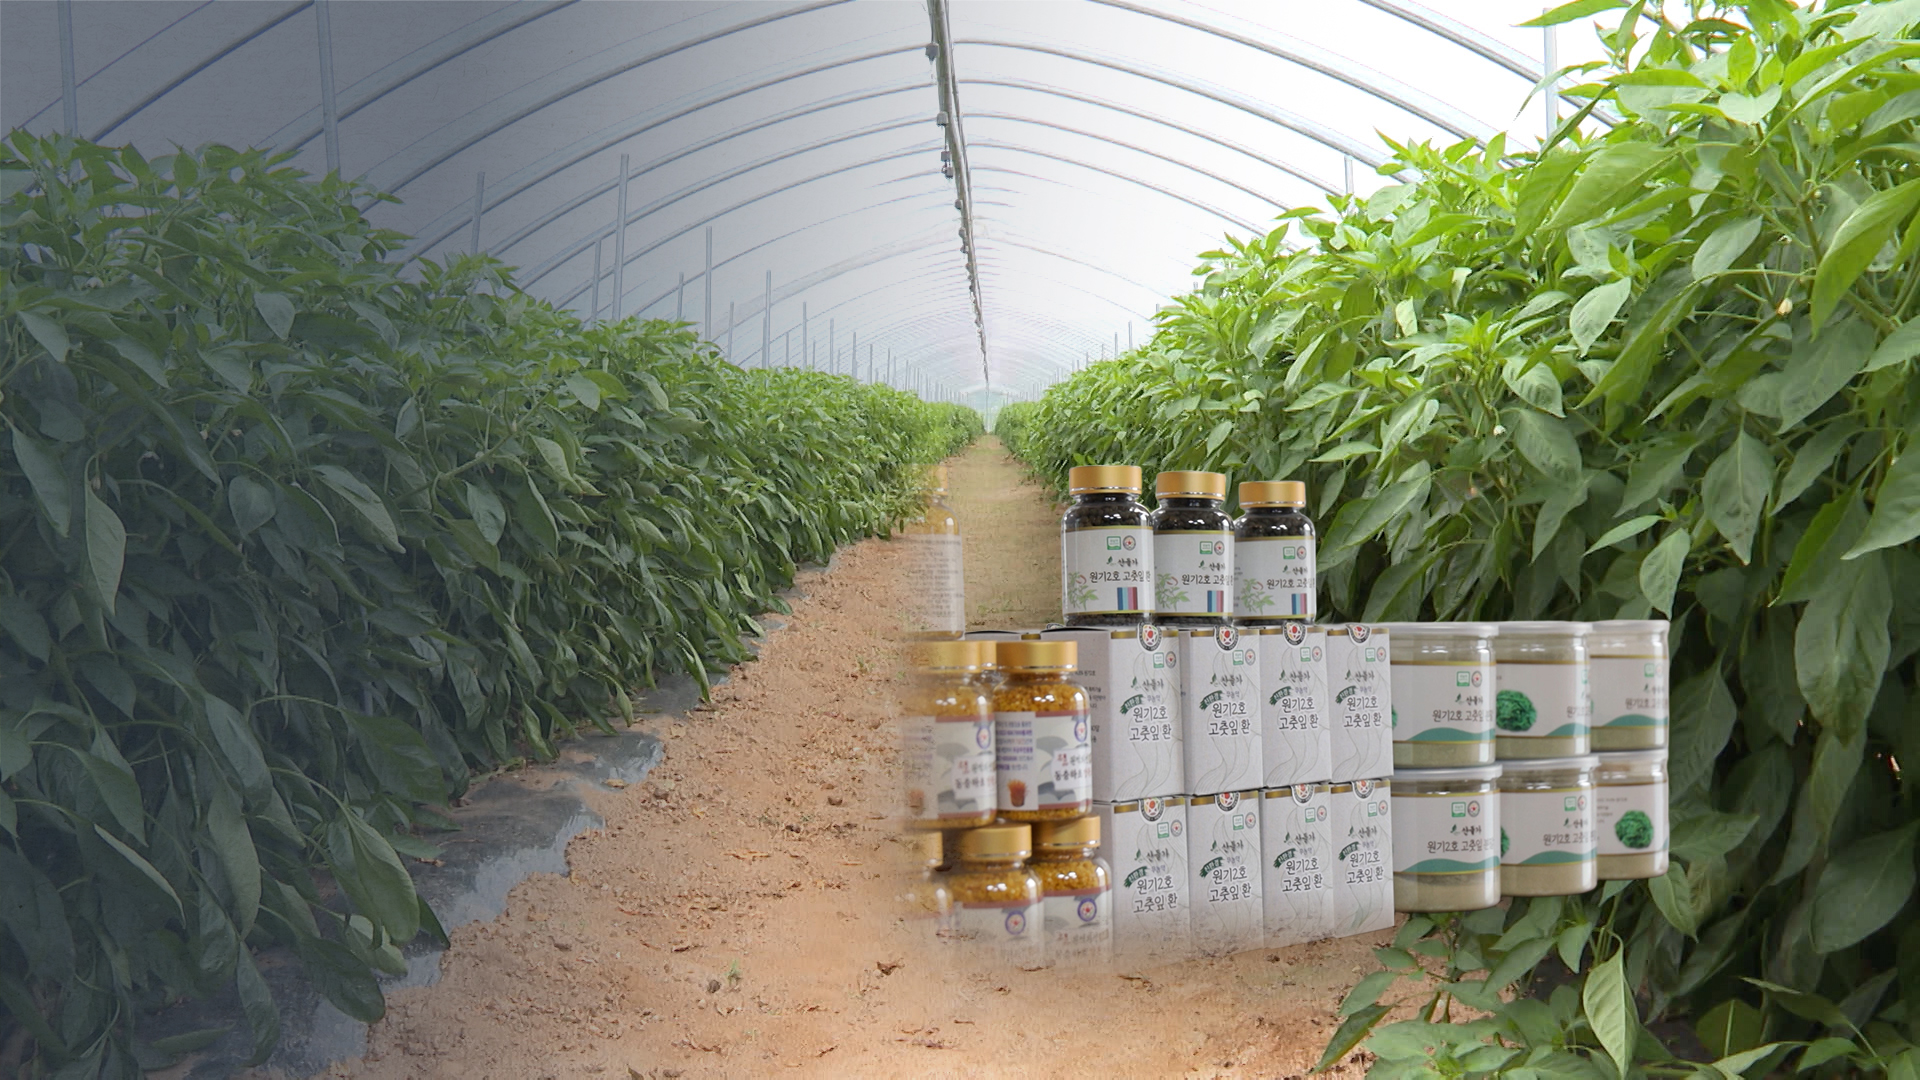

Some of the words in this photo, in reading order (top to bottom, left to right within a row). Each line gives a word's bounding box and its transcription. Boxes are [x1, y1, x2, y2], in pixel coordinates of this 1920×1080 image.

[1089, 570, 1120, 583] 원기2호
[1181, 574, 1211, 585] 원기2호
[1266, 578, 1295, 590] 원기2호
[1212, 702, 1247, 718] 원기2호
[1281, 697, 1315, 713] 원기2호
[1347, 696, 1379, 712] 원기2호
[1133, 706, 1168, 723] 원기2호
[1279, 714, 1307, 730] 고춧잎
[1310, 714, 1319, 729] 환
[1344, 712, 1371, 728] 고춧잎
[1373, 712, 1382, 727] 환
[1432, 709, 1463, 722] 원기2호
[1129, 725, 1159, 742] 고춧잎
[1162, 723, 1172, 740] 환
[1208, 720, 1238, 736] 고춧잎
[1241, 719, 1250, 734] 환
[1427, 841, 1459, 854] 원기2호
[1543, 833, 1571, 847] 원기2호
[1286, 857, 1319, 875] 원기2호
[1350, 851, 1380, 868] 원기2호
[1212, 866, 1247, 885] 원기2호
[1282, 875, 1311, 892] 고춧잎
[1313, 874, 1323, 889] 환
[1346, 868, 1373, 884] 고춧잎
[1375, 866, 1384, 880] 환
[1137, 875, 1174, 895] 원기2호
[1209, 885, 1239, 902] 고춧잎
[1242, 882, 1251, 898] 환
[1133, 895, 1165, 913] 고춧잎
[1168, 892, 1178, 909] 환
